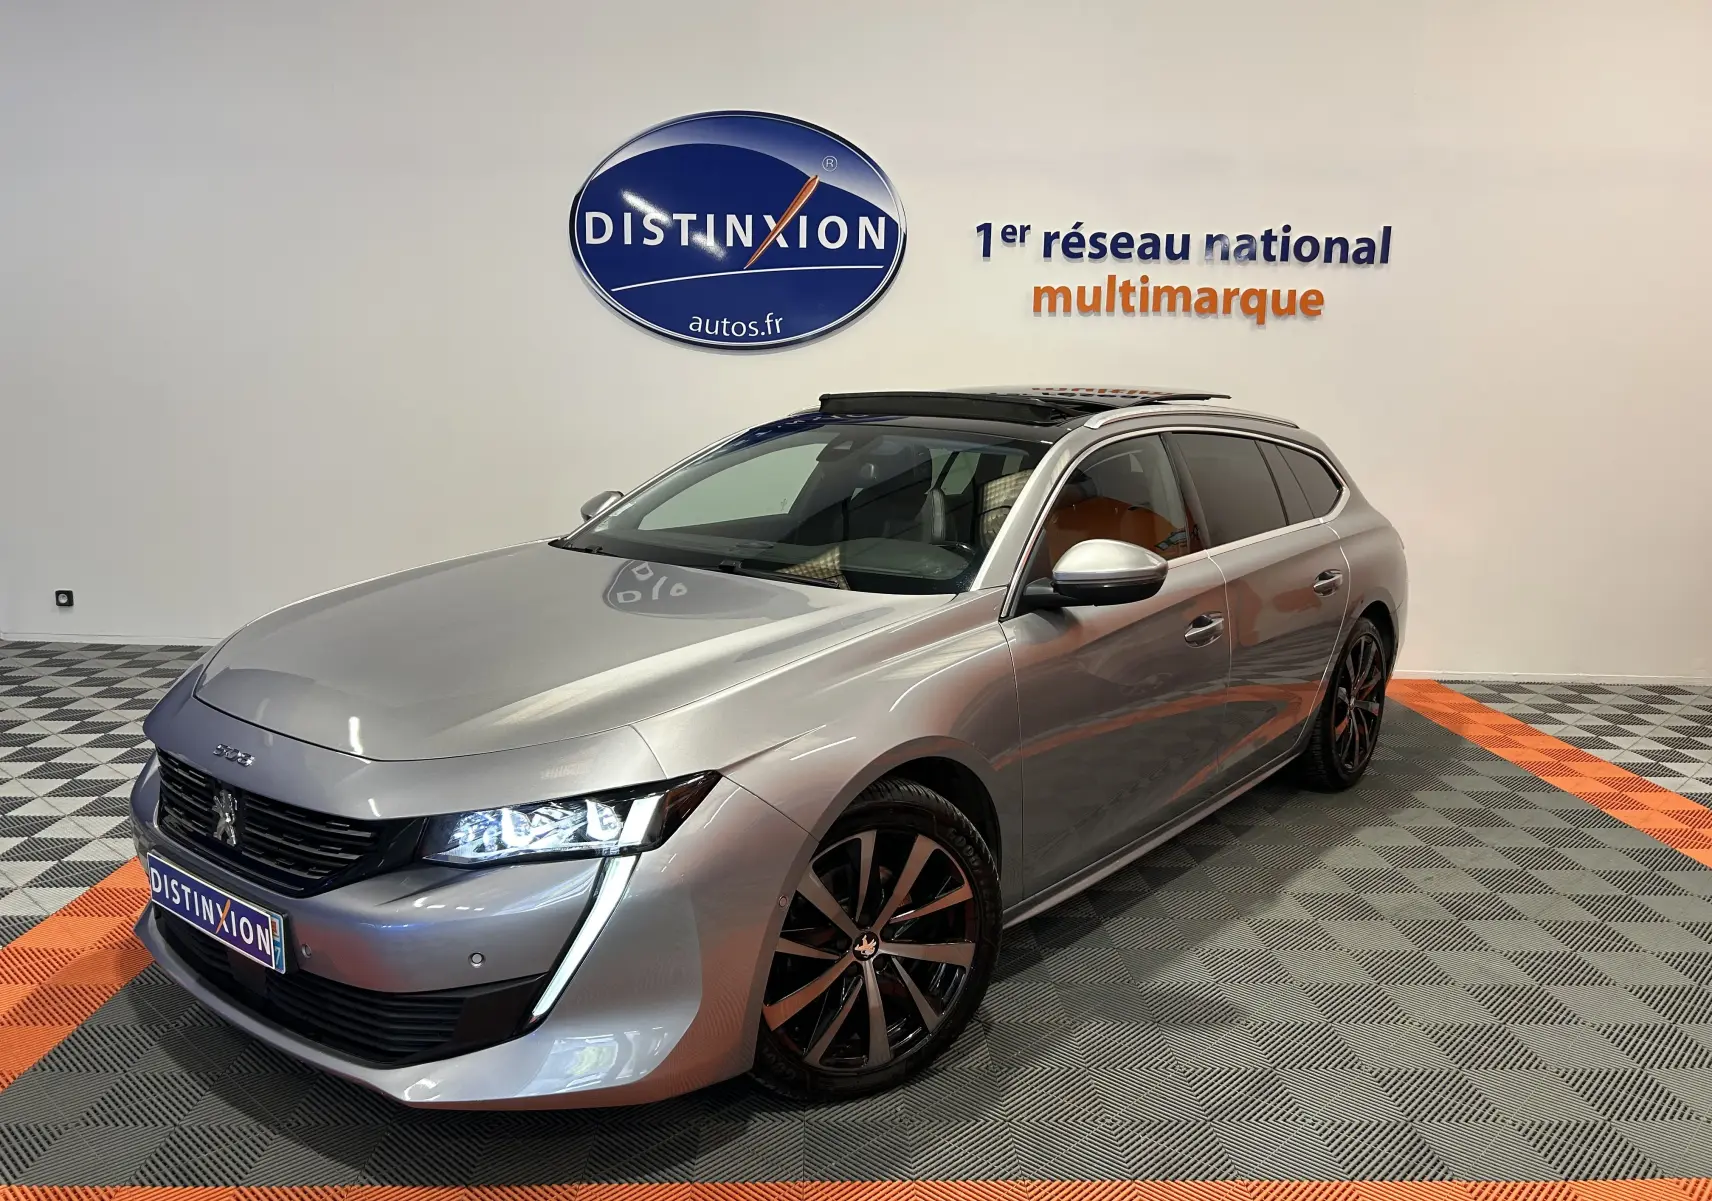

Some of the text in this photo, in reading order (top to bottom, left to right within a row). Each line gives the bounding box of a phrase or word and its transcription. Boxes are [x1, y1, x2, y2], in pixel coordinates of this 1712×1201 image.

[585, 211, 886, 250] DISTINXION
[976, 222, 1392, 265] 1er réseau national
[1032, 274, 1325, 326] multimarque
[689, 312, 784, 338] autos.fr
[151, 866, 271, 956] DISTINXION
